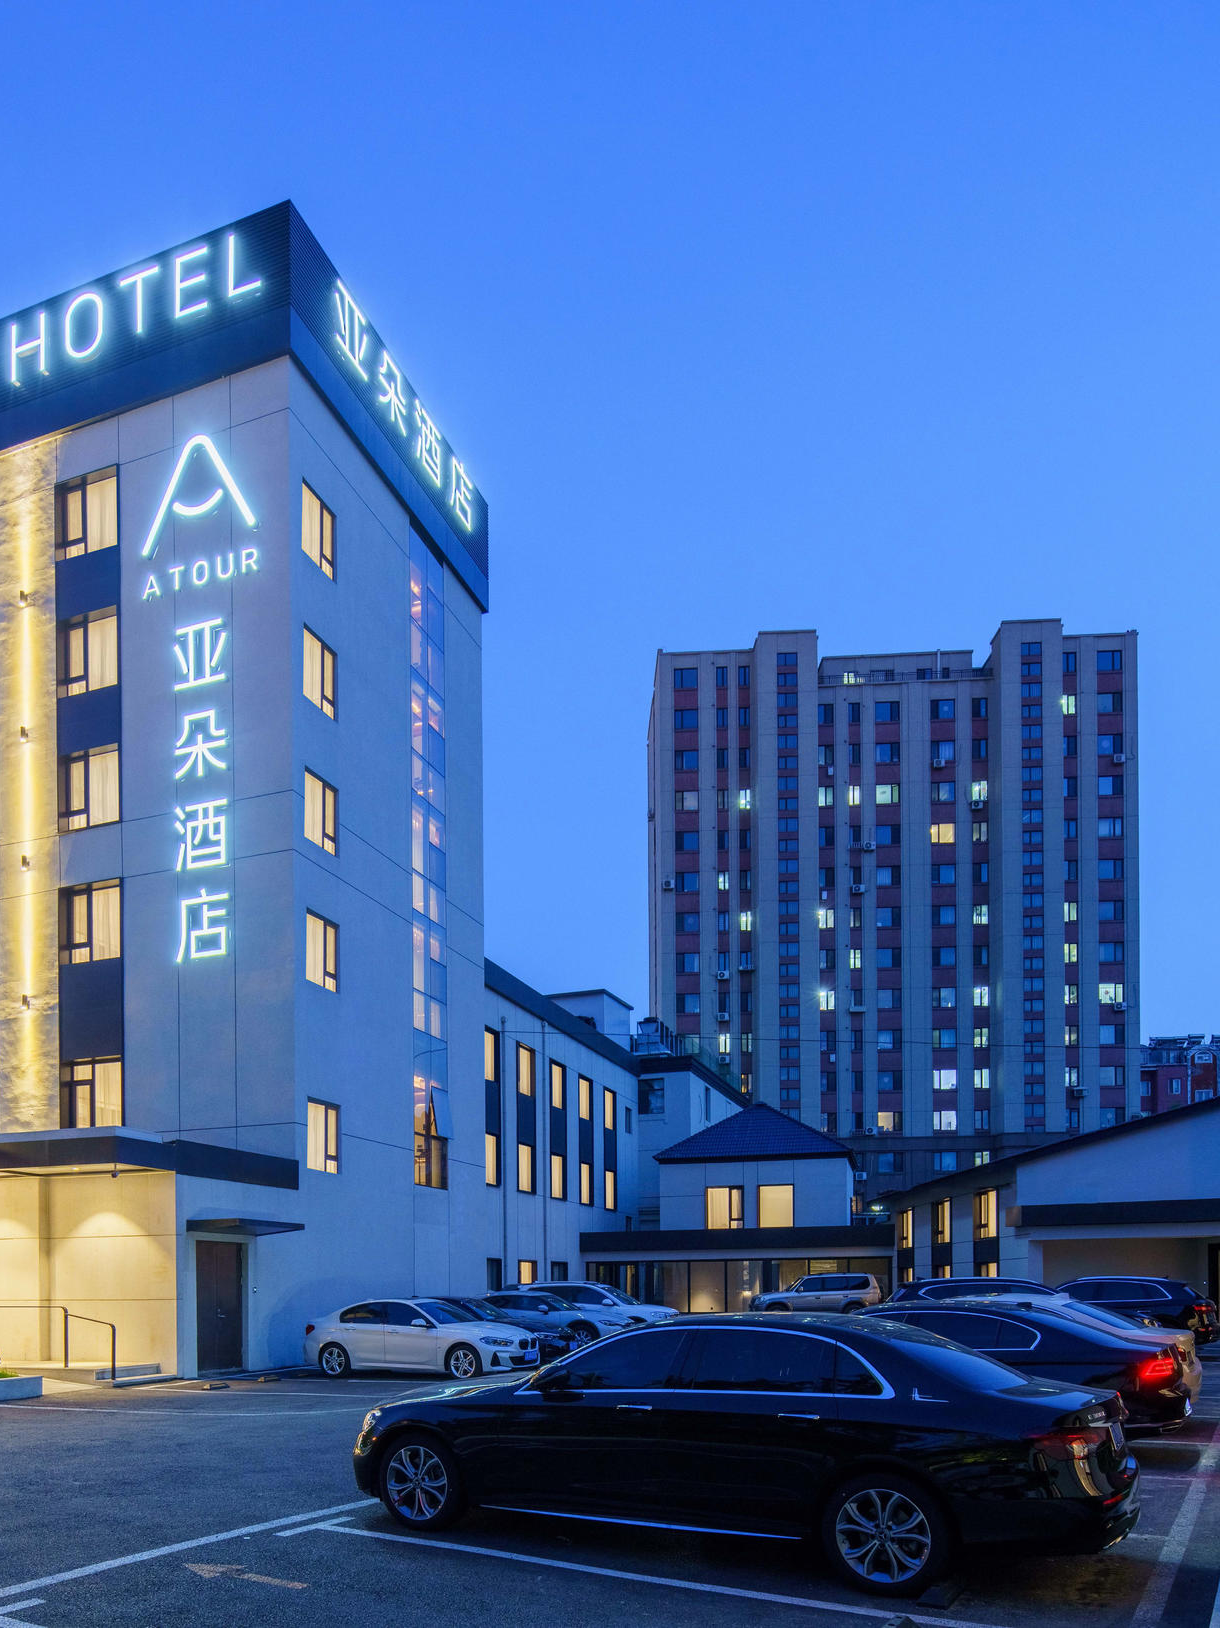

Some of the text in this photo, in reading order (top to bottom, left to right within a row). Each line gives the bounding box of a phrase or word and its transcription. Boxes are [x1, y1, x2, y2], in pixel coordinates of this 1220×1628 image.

[10, 232, 262, 384] HOTEL
[333, 278, 473, 533] 亚朵酒店
[143, 547, 258, 600] ATOUR
[173, 616, 229, 963] 亚朵酒店
